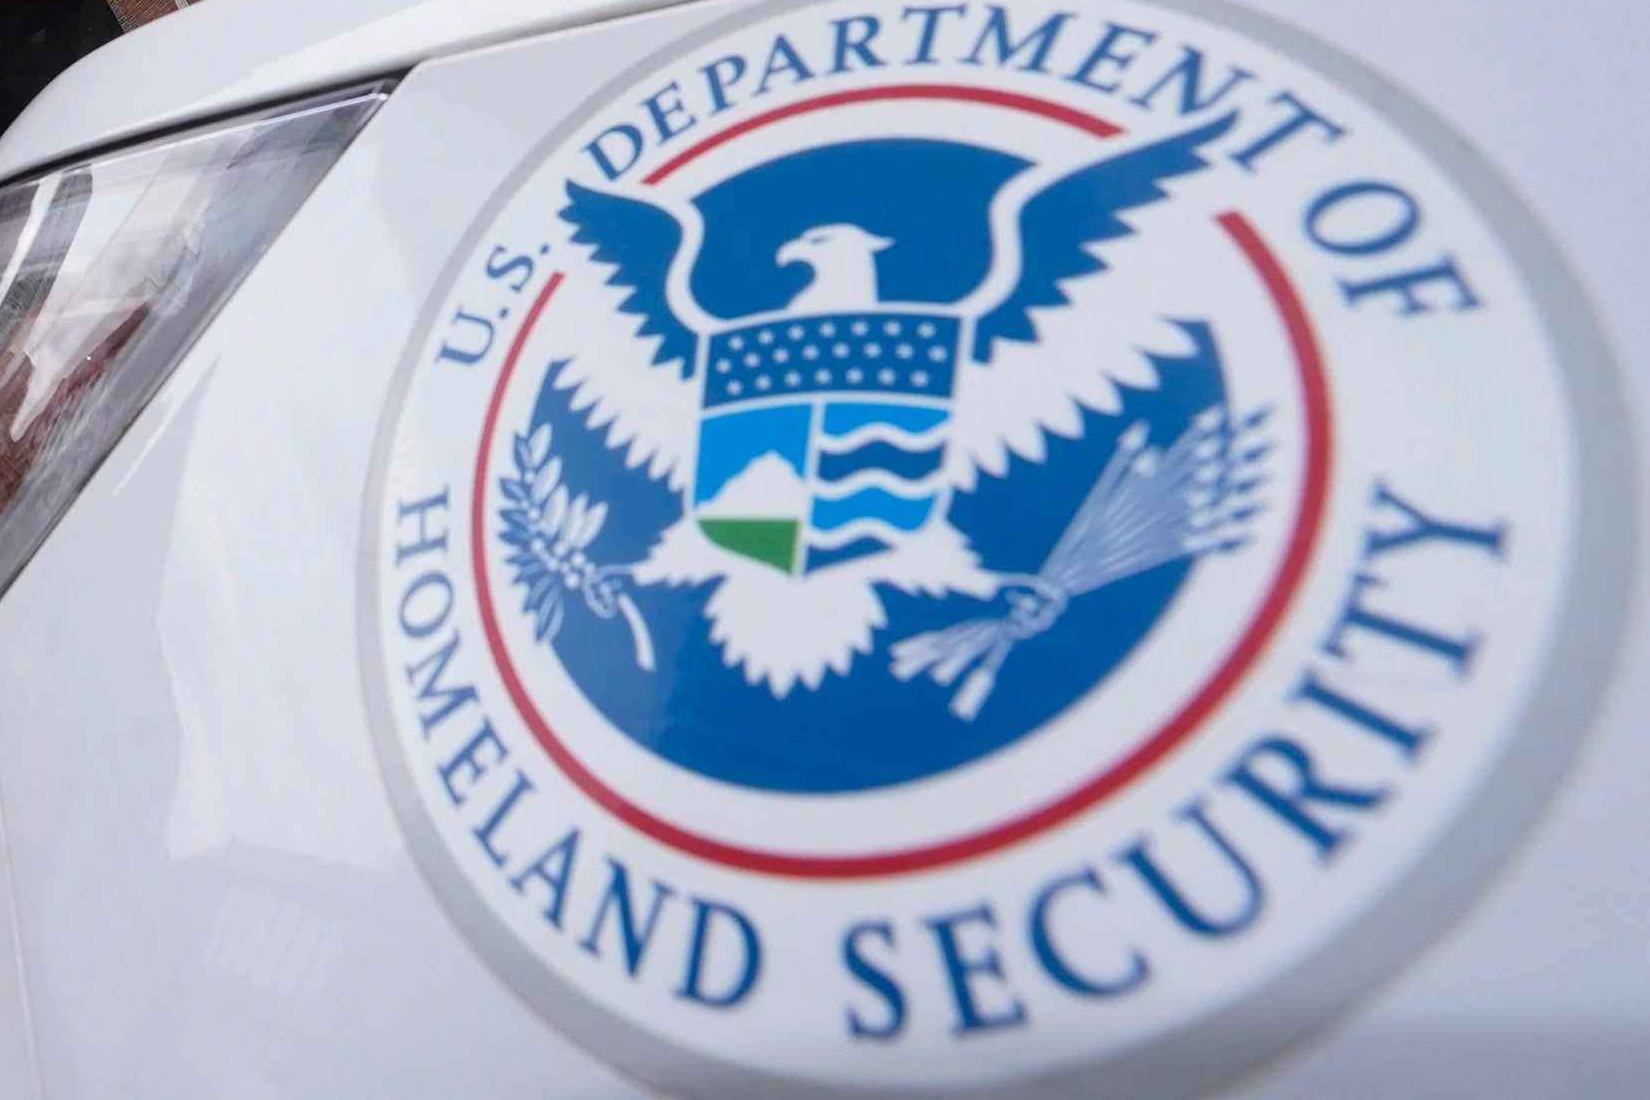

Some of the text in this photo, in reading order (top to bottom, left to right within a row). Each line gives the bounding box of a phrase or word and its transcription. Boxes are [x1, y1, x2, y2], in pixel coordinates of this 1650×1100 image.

[434, 3, 1483, 369] U.S. DEPARTMENT OF
[394, 479, 1509, 1042] HOMELAND SECURITY
